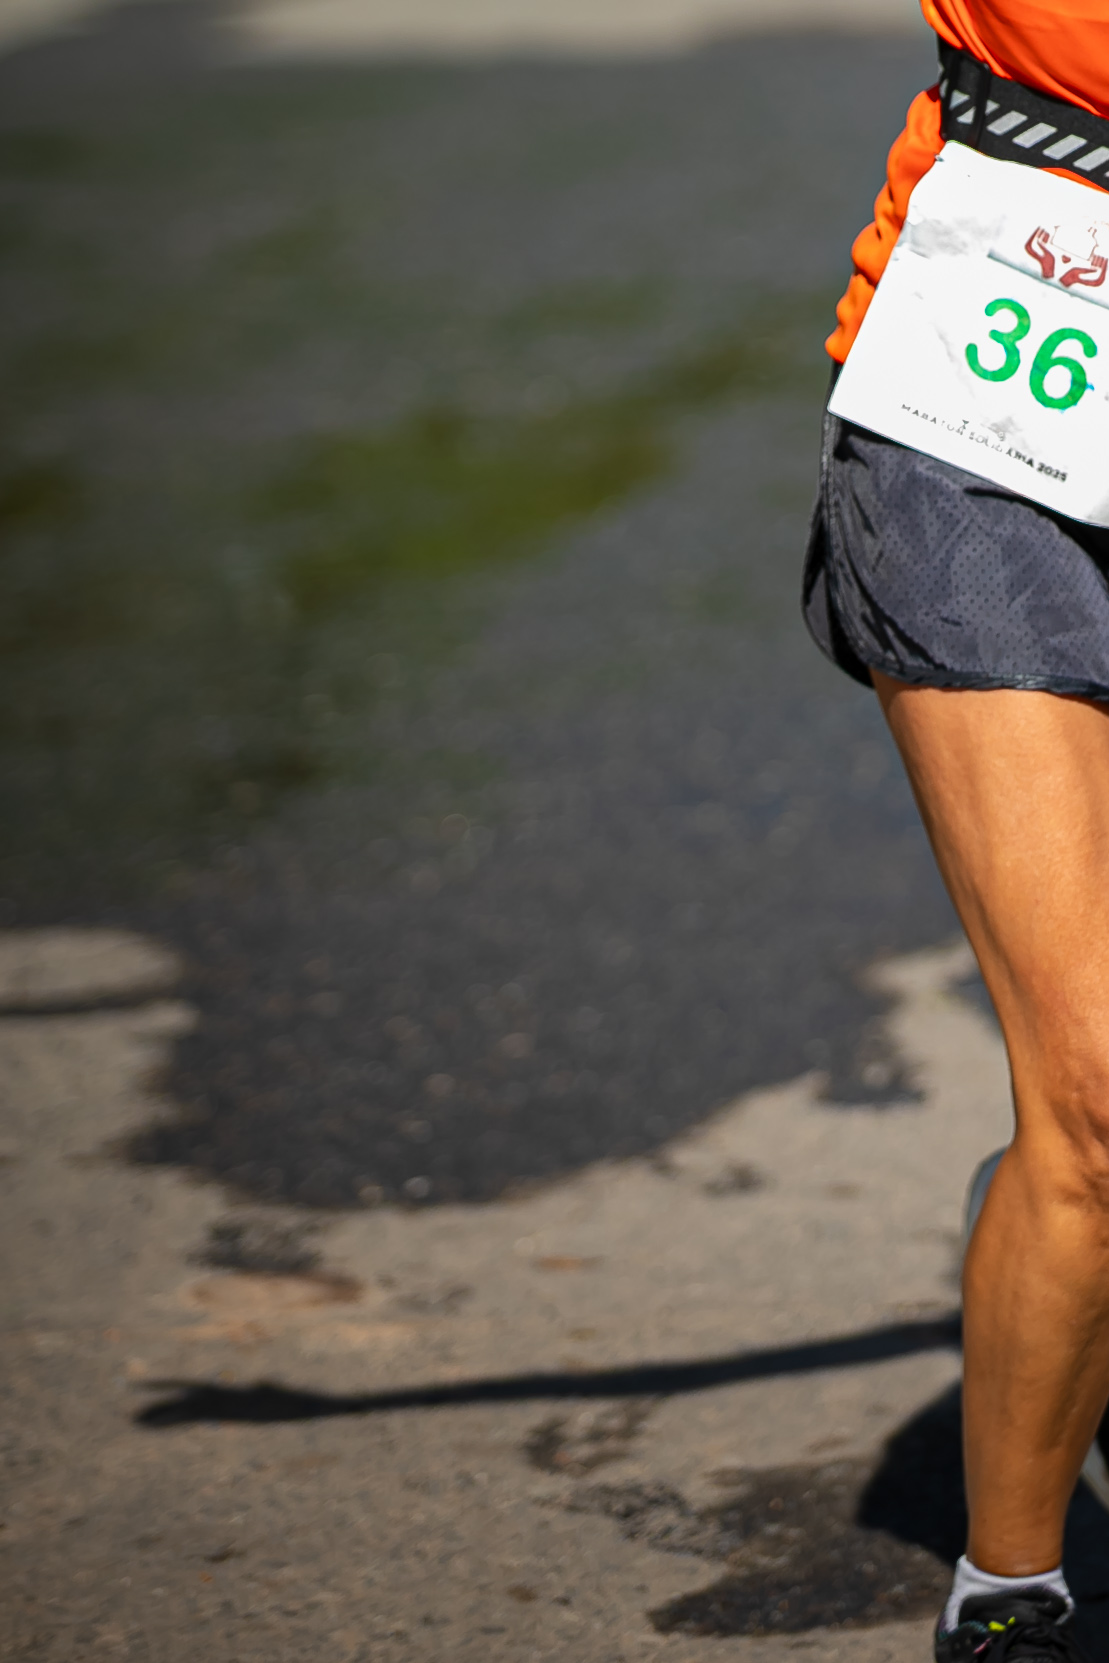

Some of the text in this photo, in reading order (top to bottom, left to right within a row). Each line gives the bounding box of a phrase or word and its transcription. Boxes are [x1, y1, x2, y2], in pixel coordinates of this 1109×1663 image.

[965, 298, 1098, 410] 36
[901, 403, 966, 435] MARAON
[1037, 461, 1067, 482] 2025
